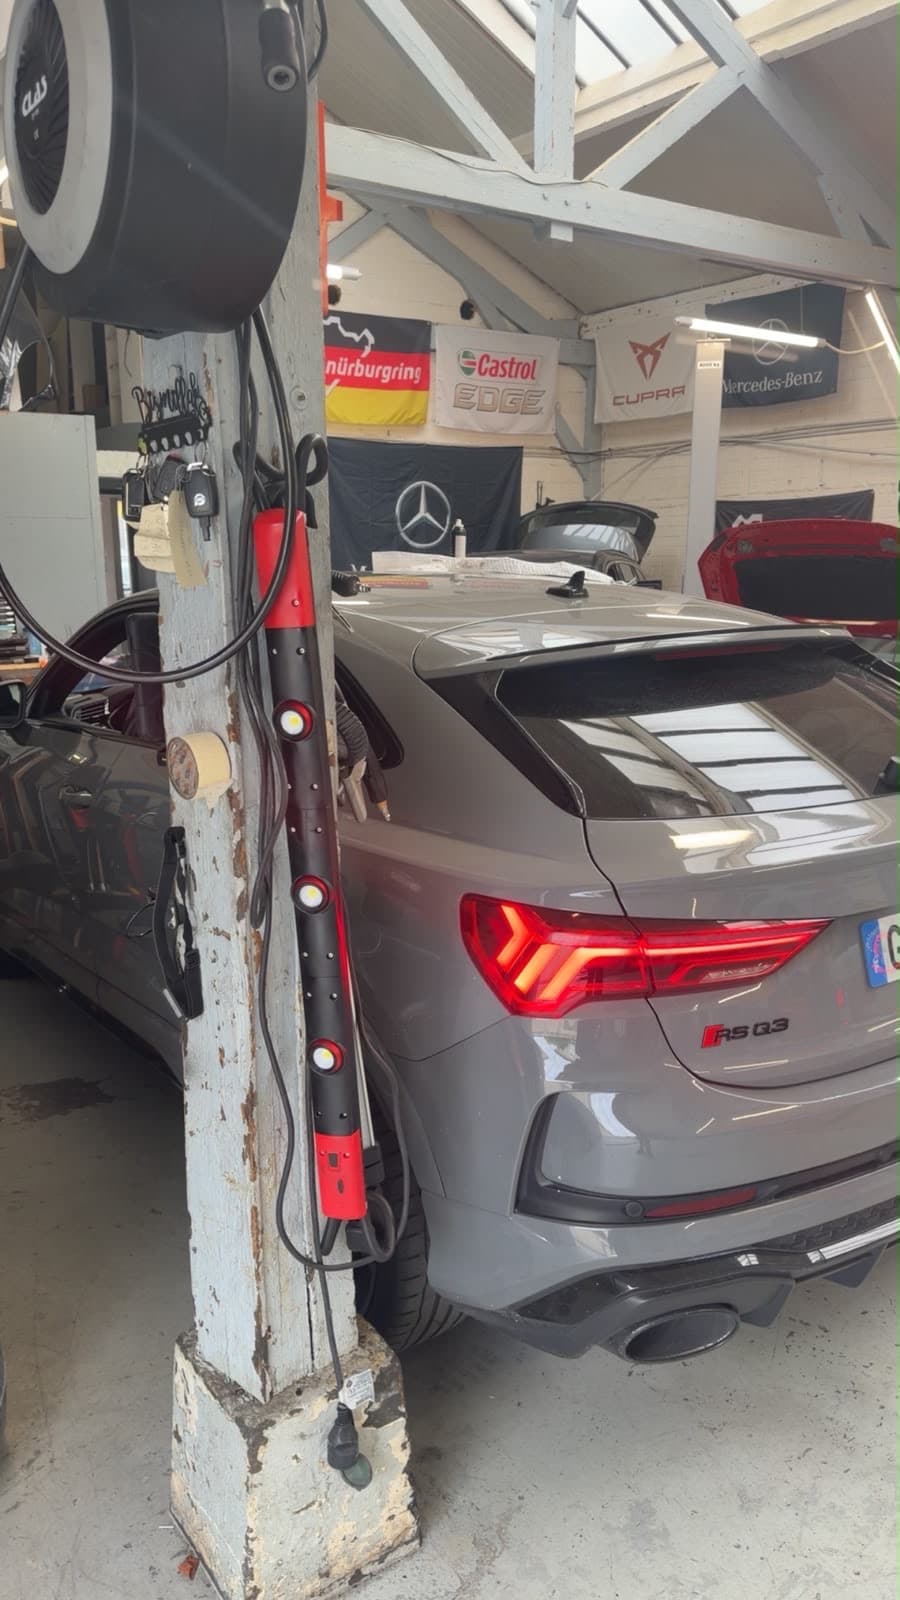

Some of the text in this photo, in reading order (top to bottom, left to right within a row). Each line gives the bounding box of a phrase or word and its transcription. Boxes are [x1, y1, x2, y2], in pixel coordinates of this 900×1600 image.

[325, 357, 422, 384] nürburgring
[478, 353, 537, 380] Castrol
[721, 370, 823, 393] Mercedes-Benz
[453, 382, 546, 415] EDGE
[612, 385, 686, 406] CUPRA
[752, 1017, 789, 1036] Q3
